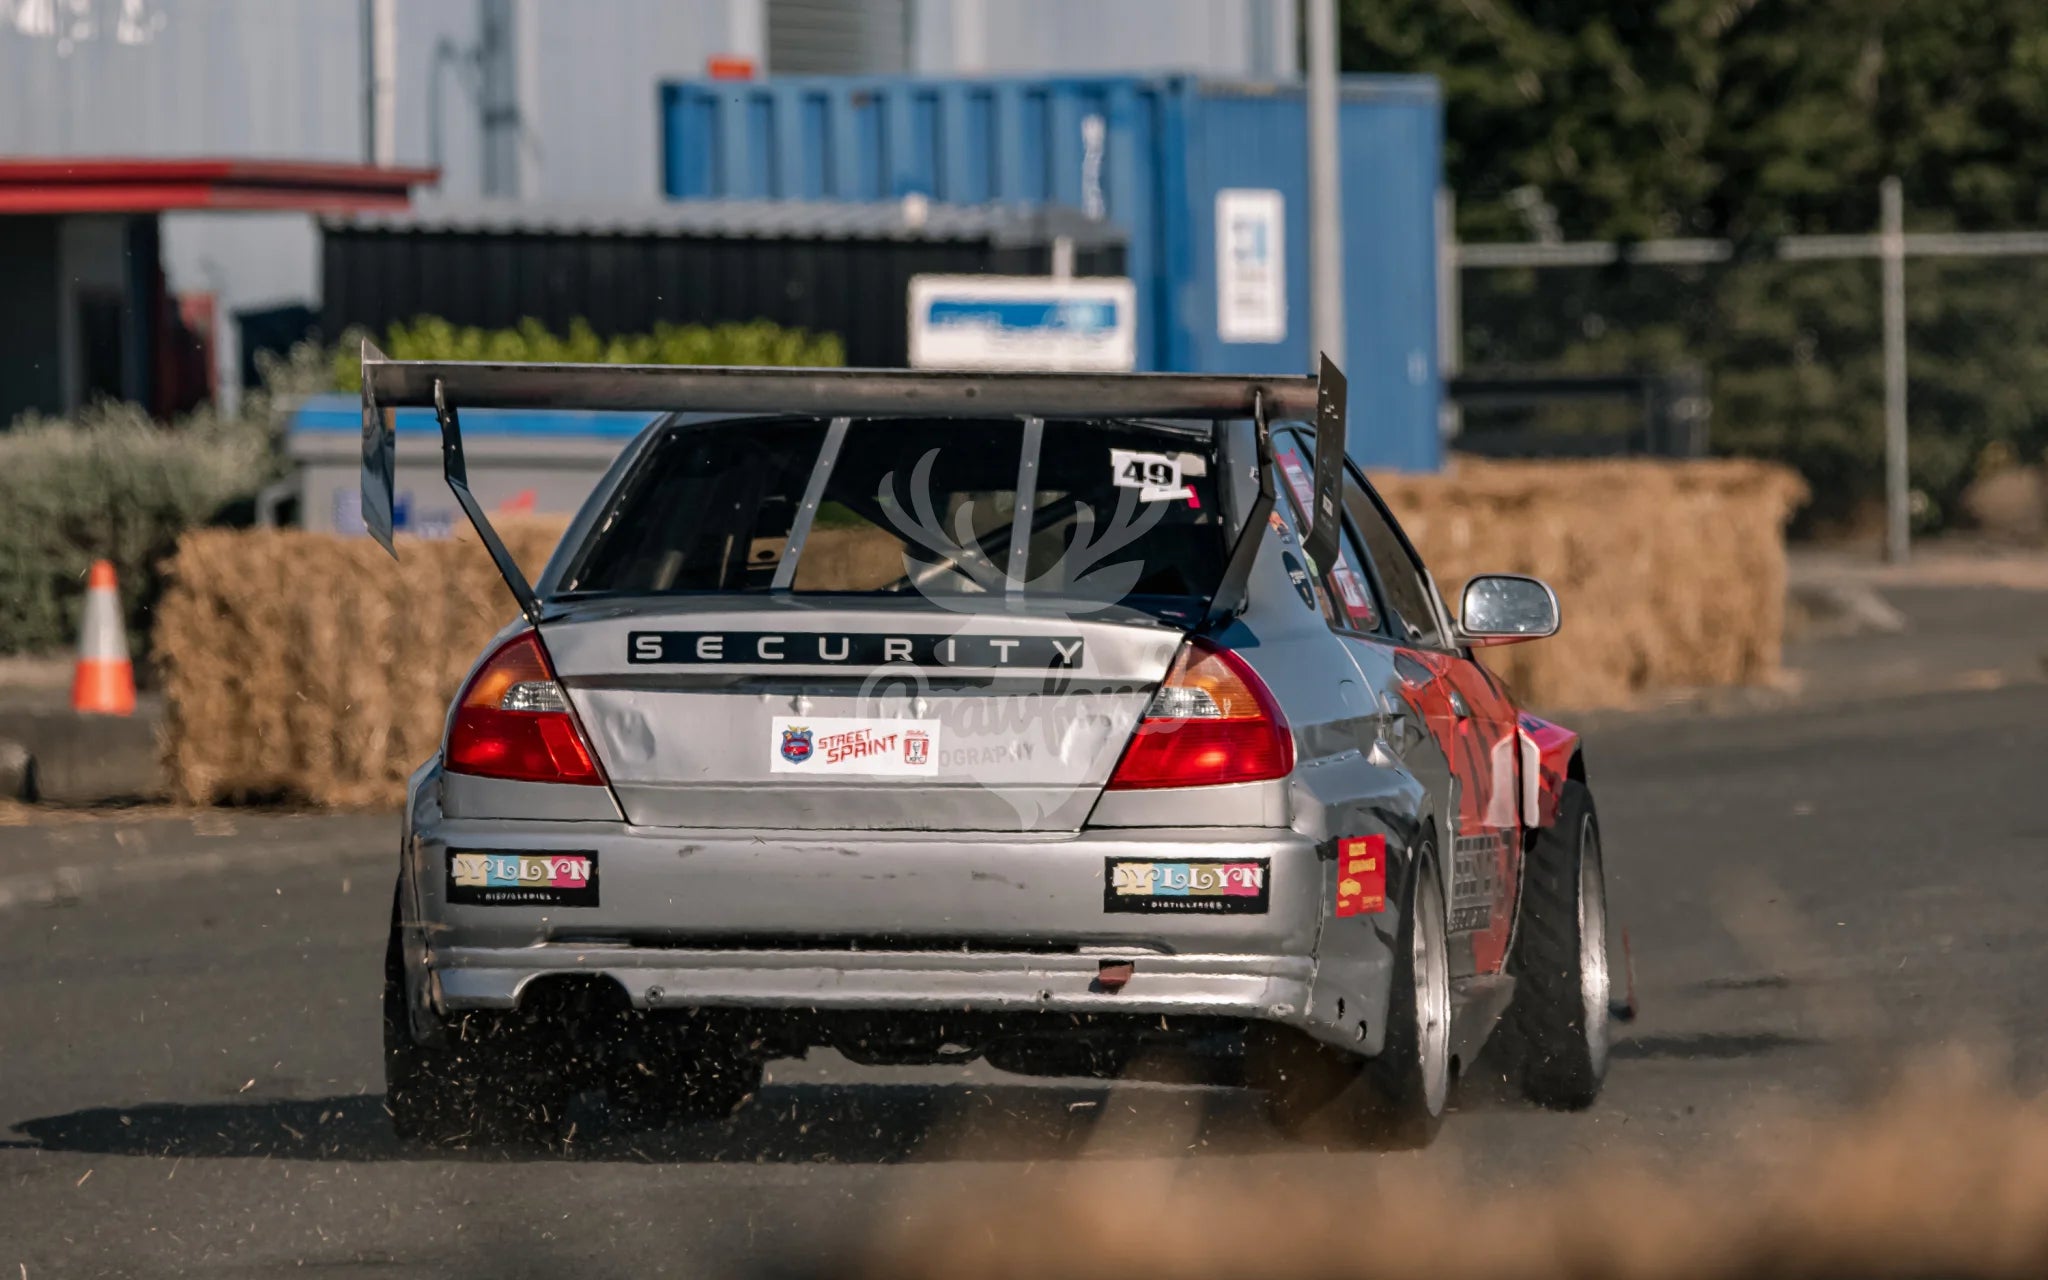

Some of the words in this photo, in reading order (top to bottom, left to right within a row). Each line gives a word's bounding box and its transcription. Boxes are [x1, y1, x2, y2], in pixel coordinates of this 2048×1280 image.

[1122, 460, 1174, 486] 49
[636, 636, 1083, 664] SECURITY
[818, 728, 873, 750] STREET
[826, 734, 898, 765] SPRINT
[451, 857, 593, 881] DYLLYN
[1112, 866, 1265, 890] DYLLYN
